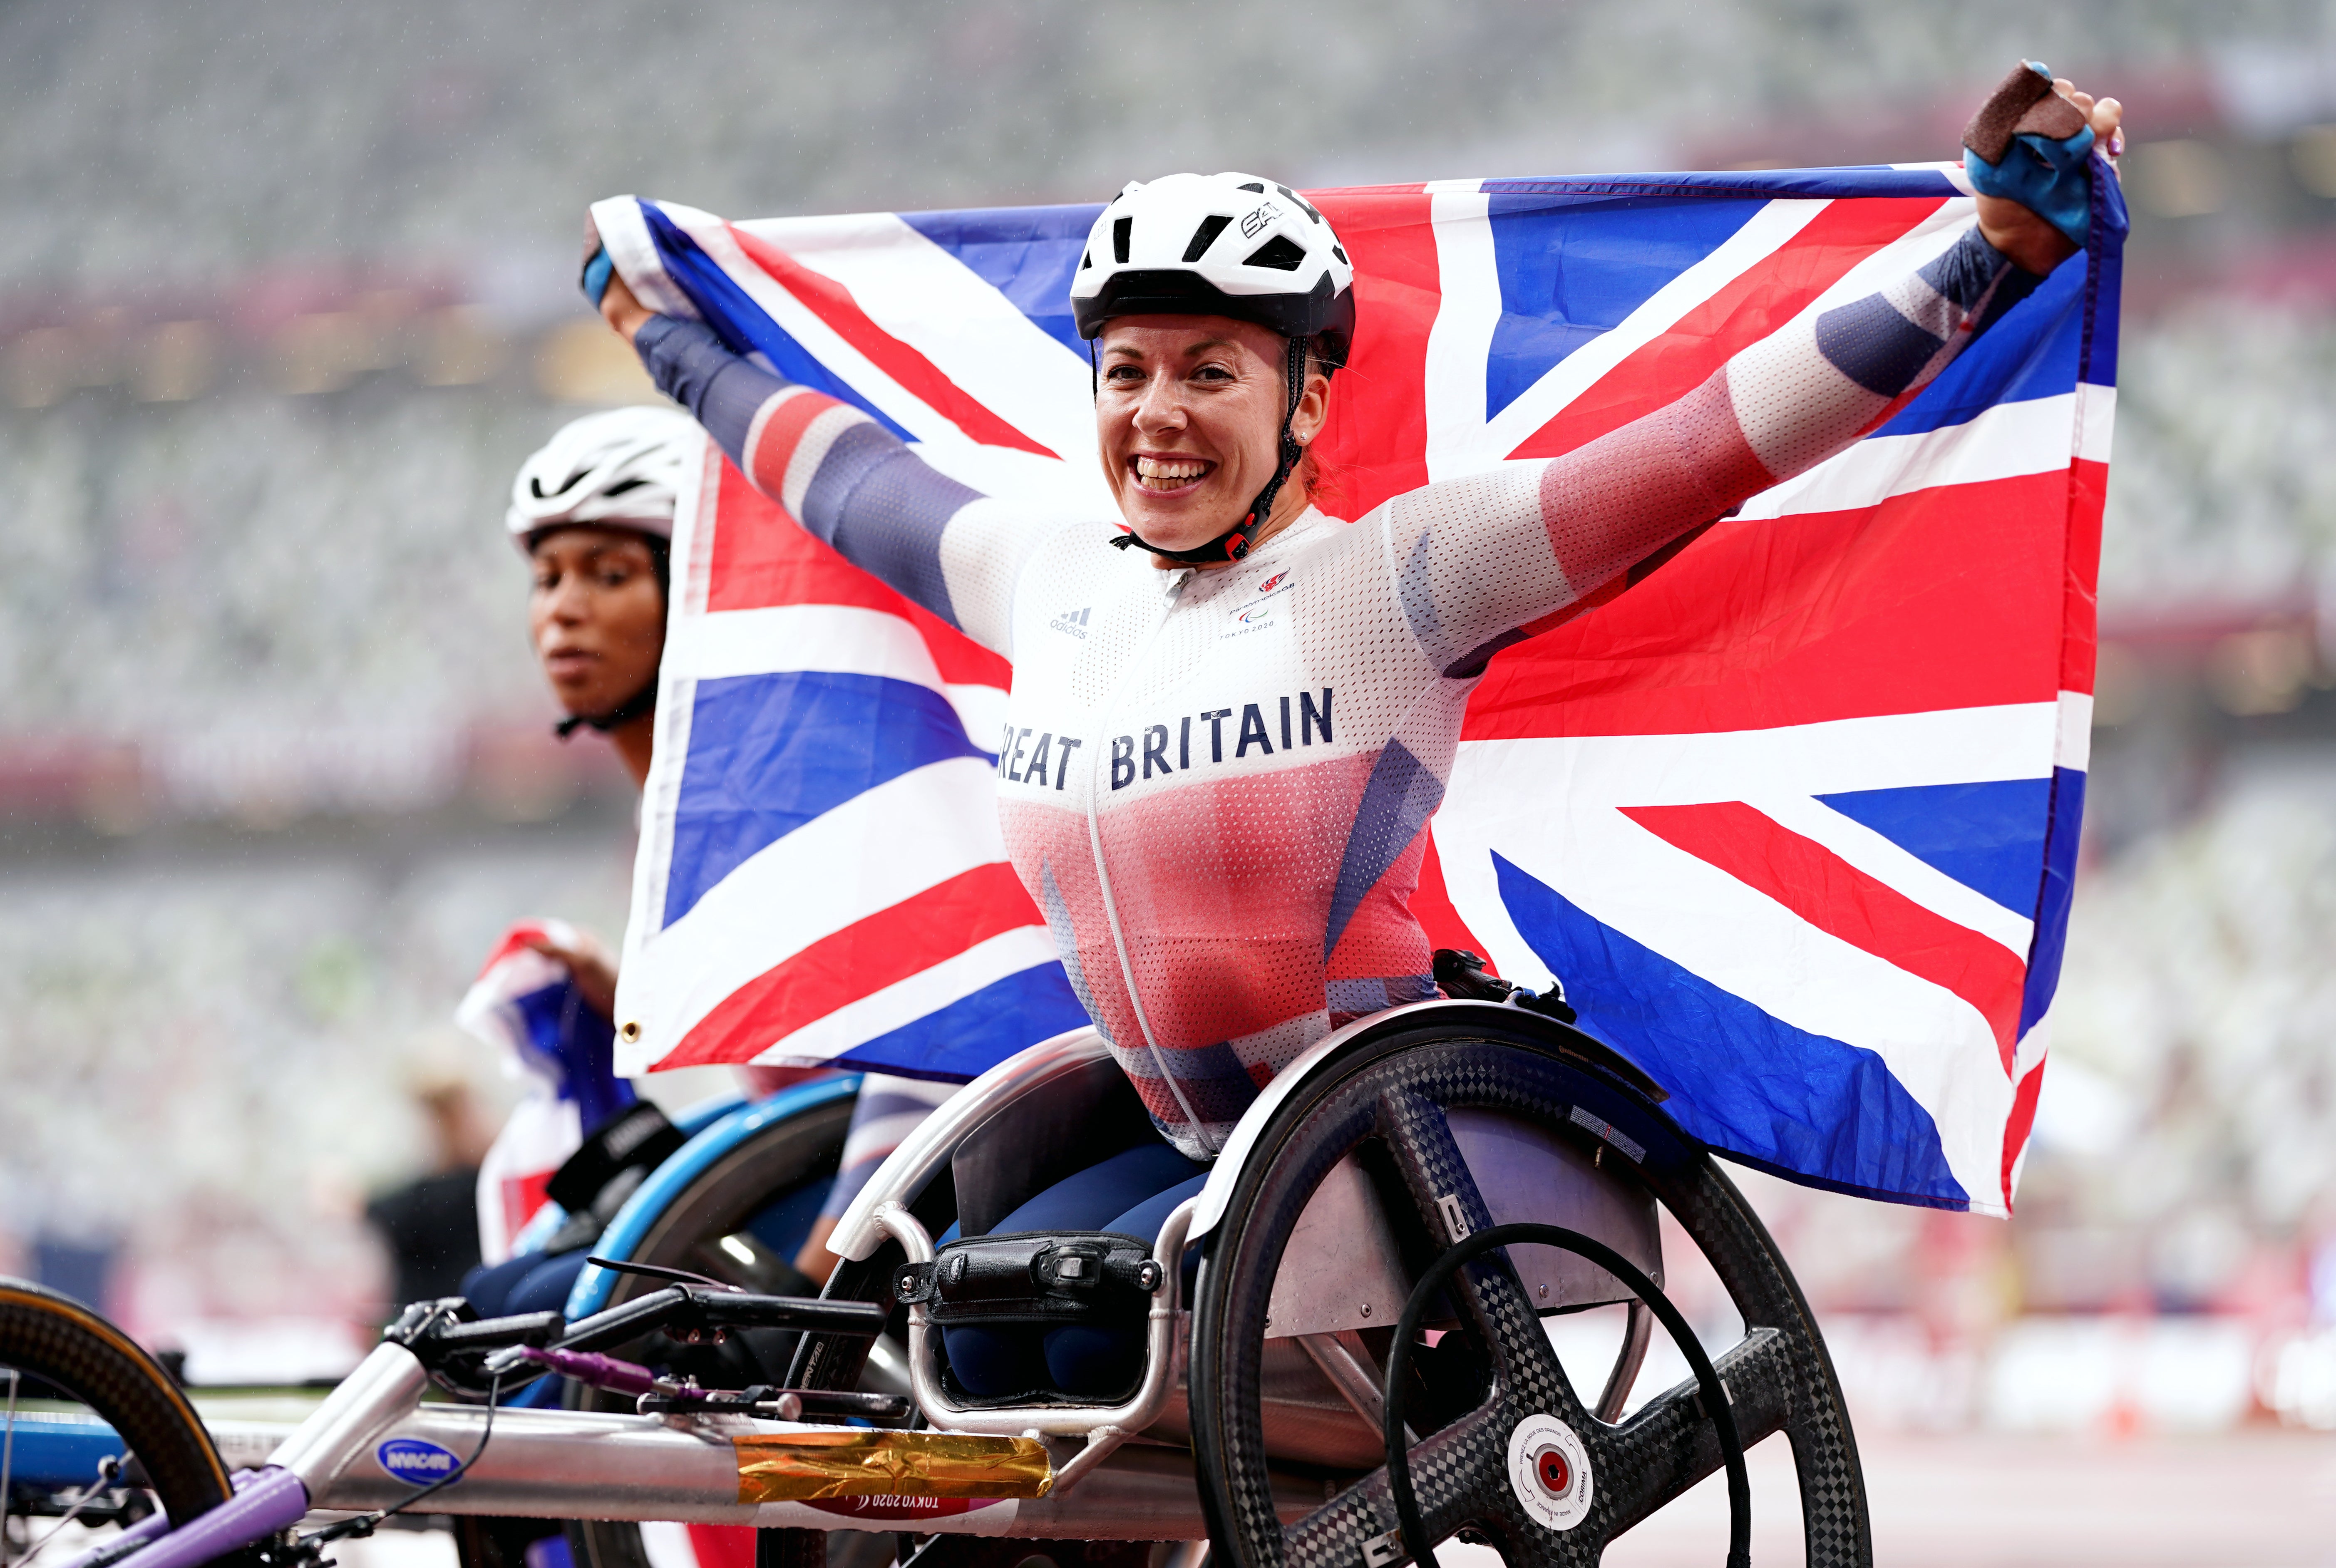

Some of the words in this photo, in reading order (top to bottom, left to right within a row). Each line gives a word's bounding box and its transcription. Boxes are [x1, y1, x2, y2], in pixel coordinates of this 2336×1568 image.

[1050, 620, 1088, 639] adidas
[1219, 628, 1249, 640] TOKYO
[1252, 621, 1274, 632] 2020
[998, 723, 1081, 790] REAT
[1112, 688, 1333, 791] BRITAIN
[1527, 1430, 1537, 1440] ROUE
[1544, 1427, 1561, 1437] GRANDS
[872, 1494, 901, 1507] 2020
[902, 1495, 938, 1508] TOKYO
[1537, 1501, 1553, 1516] FRANCE
